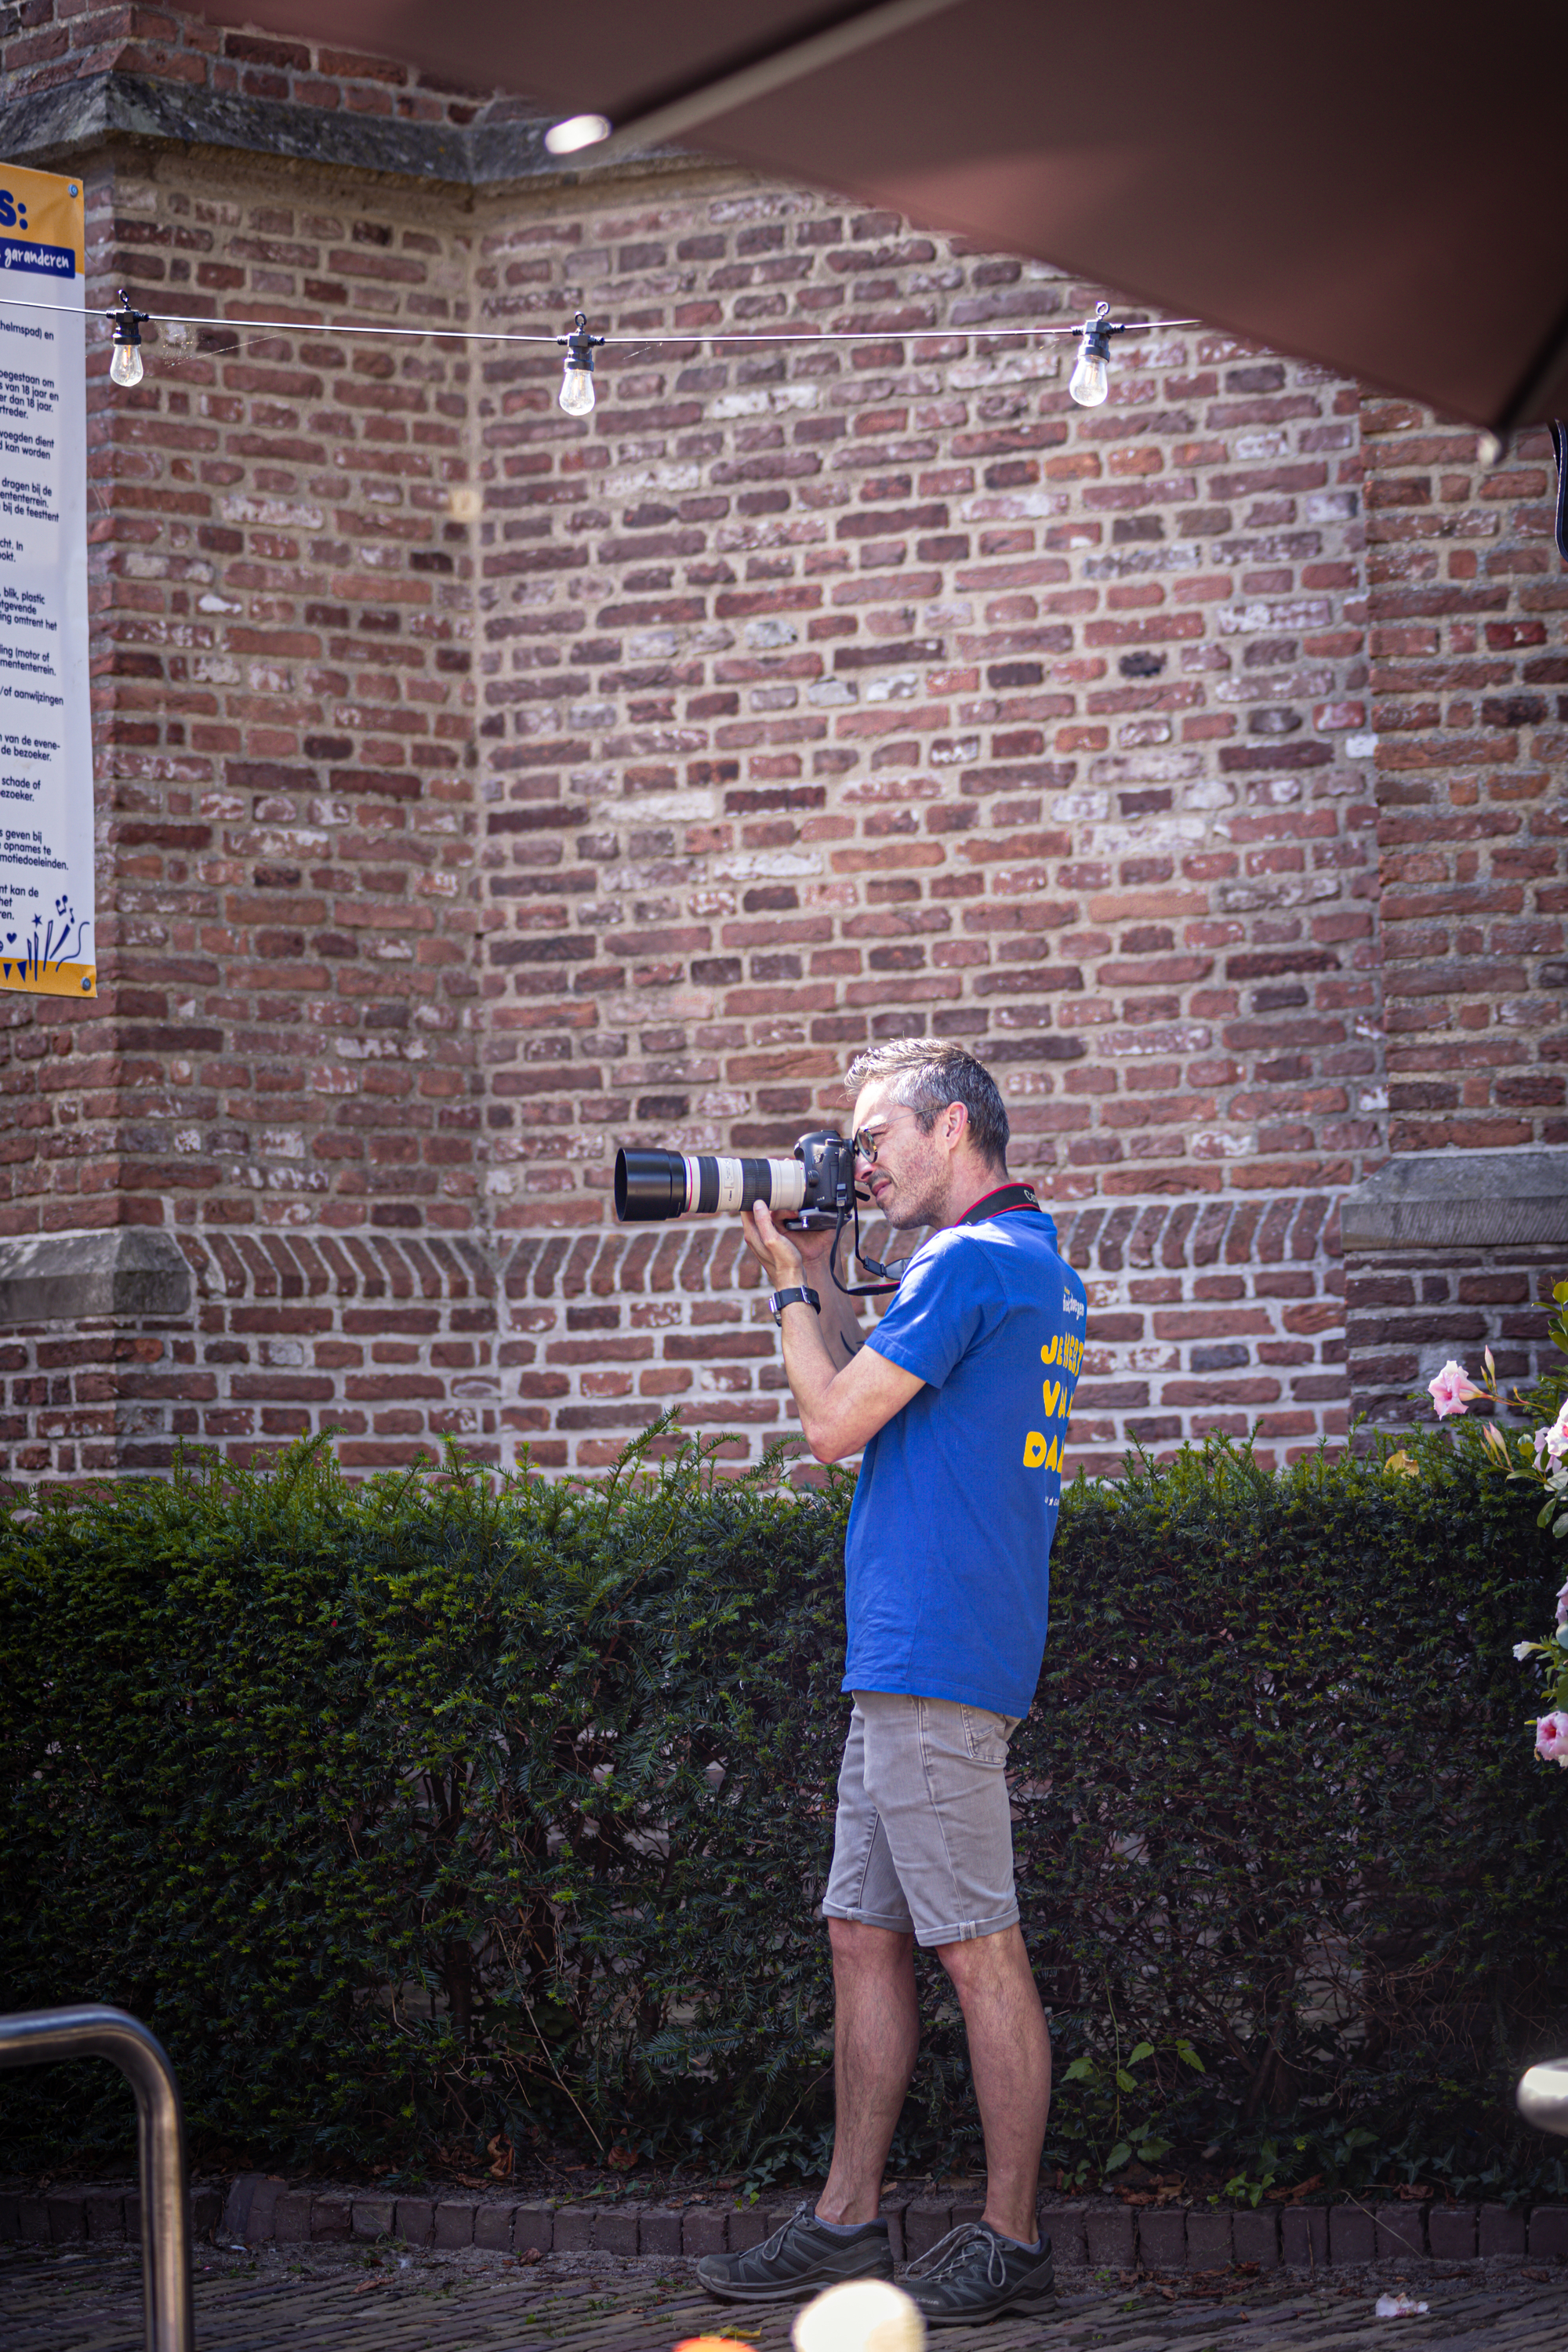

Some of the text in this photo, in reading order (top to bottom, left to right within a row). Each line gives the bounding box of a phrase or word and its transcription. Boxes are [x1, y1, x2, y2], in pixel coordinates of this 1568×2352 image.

[5, 247, 70, 269] garanderen
[44, 331, 54, 340] en
[42, 379, 54, 388] om
[5, 383, 20, 393] van
[22, 384, 30, 395] 18
[32, 386, 47, 399] jaar
[49, 393, 59, 401] en
[9, 394, 24, 406] dan
[27, 397, 34, 408] 18
[37, 399, 53, 412] jaar.
[35, 435, 54, 448] dient
[5, 441, 20, 453] kan
[22, 447, 51, 460] worden
[2, 477, 52, 497] dragen bij de
[0, 491, 49, 508] ententerrein.
[2, 501, 60, 523] bij de feesttent
[16, 540, 24, 551] In
[4, 586, 45, 604] blik, plastic
[0, 599, 37, 615] tgevende
[14, 615, 43, 628] omtrent
[45, 619, 57, 631] het
[16, 647, 40, 661] (motor
[42, 652, 49, 662] of
[0, 659, 56, 677] mententerrein.
[14, 690, 64, 706] aanwijzingen
[5, 735, 20, 745] van
[21, 735, 32, 746] de
[34, 739, 60, 750] evene-
[1, 745, 52, 762] de bezoeker.
[2, 775, 41, 790] schade of
[0, 789, 34, 802] ezoeker.
[5, 830, 31, 840] geven
[33, 830, 42, 844] bij
[4, 842, 42, 855] opnames
[43, 845, 51, 856] te
[0, 853, 69, 870] motiedoeleinden.
[10, 884, 26, 896] kan
[28, 887, 39, 898] de
